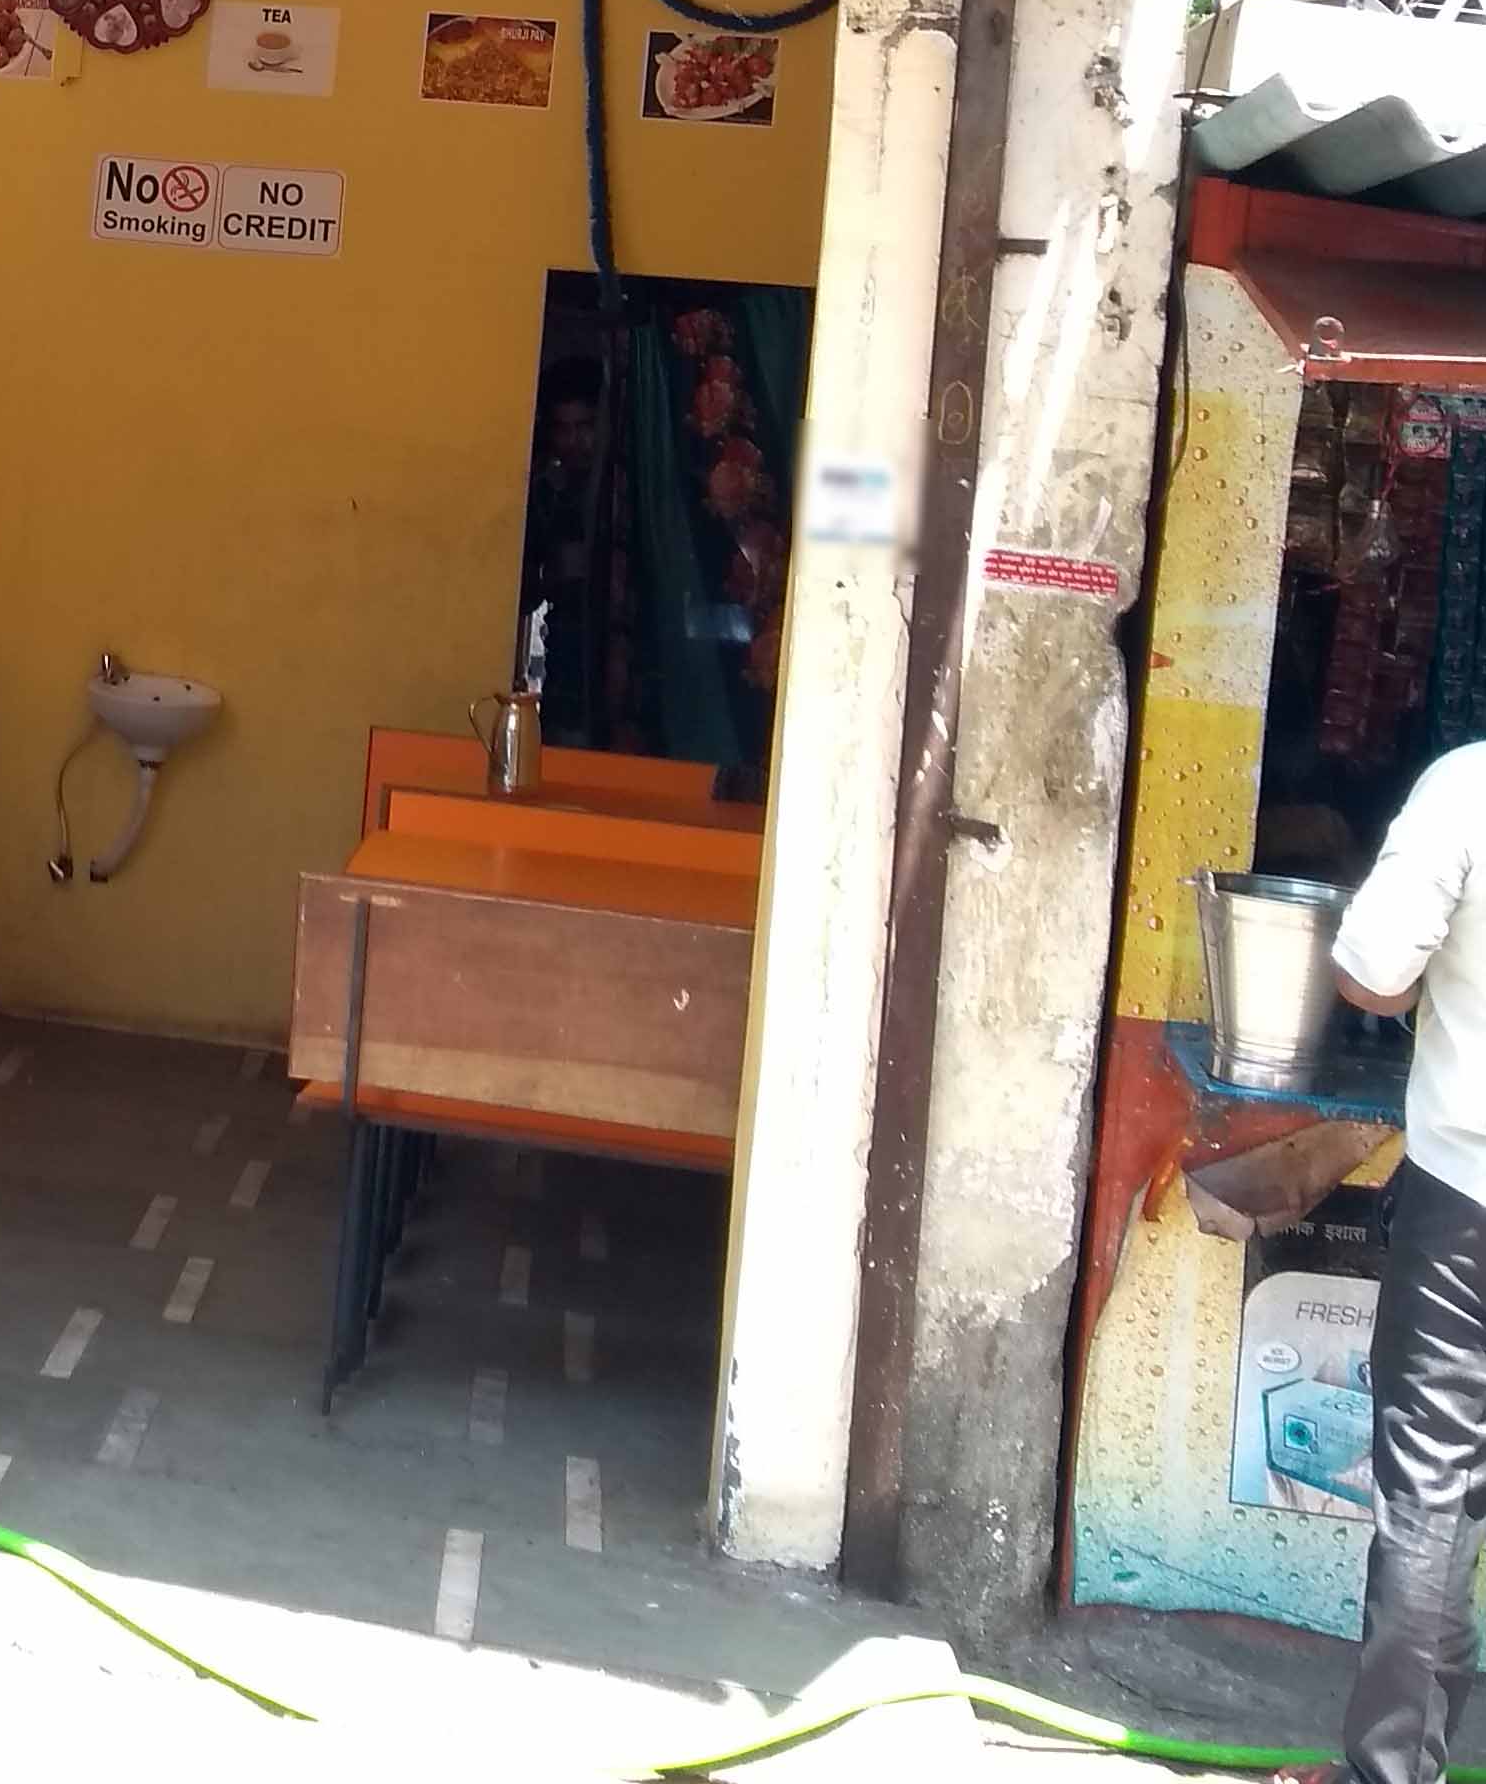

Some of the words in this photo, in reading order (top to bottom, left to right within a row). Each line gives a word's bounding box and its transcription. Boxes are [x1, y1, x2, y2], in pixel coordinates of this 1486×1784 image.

[262, 7, 292, 24] TEA
[105, 160, 160, 204] No
[259, 181, 304, 206] NO
[102, 210, 207, 242] Smoking
[223, 212, 336, 242] CREDIT
[1295, 1300, 1375, 1328] FRESH
